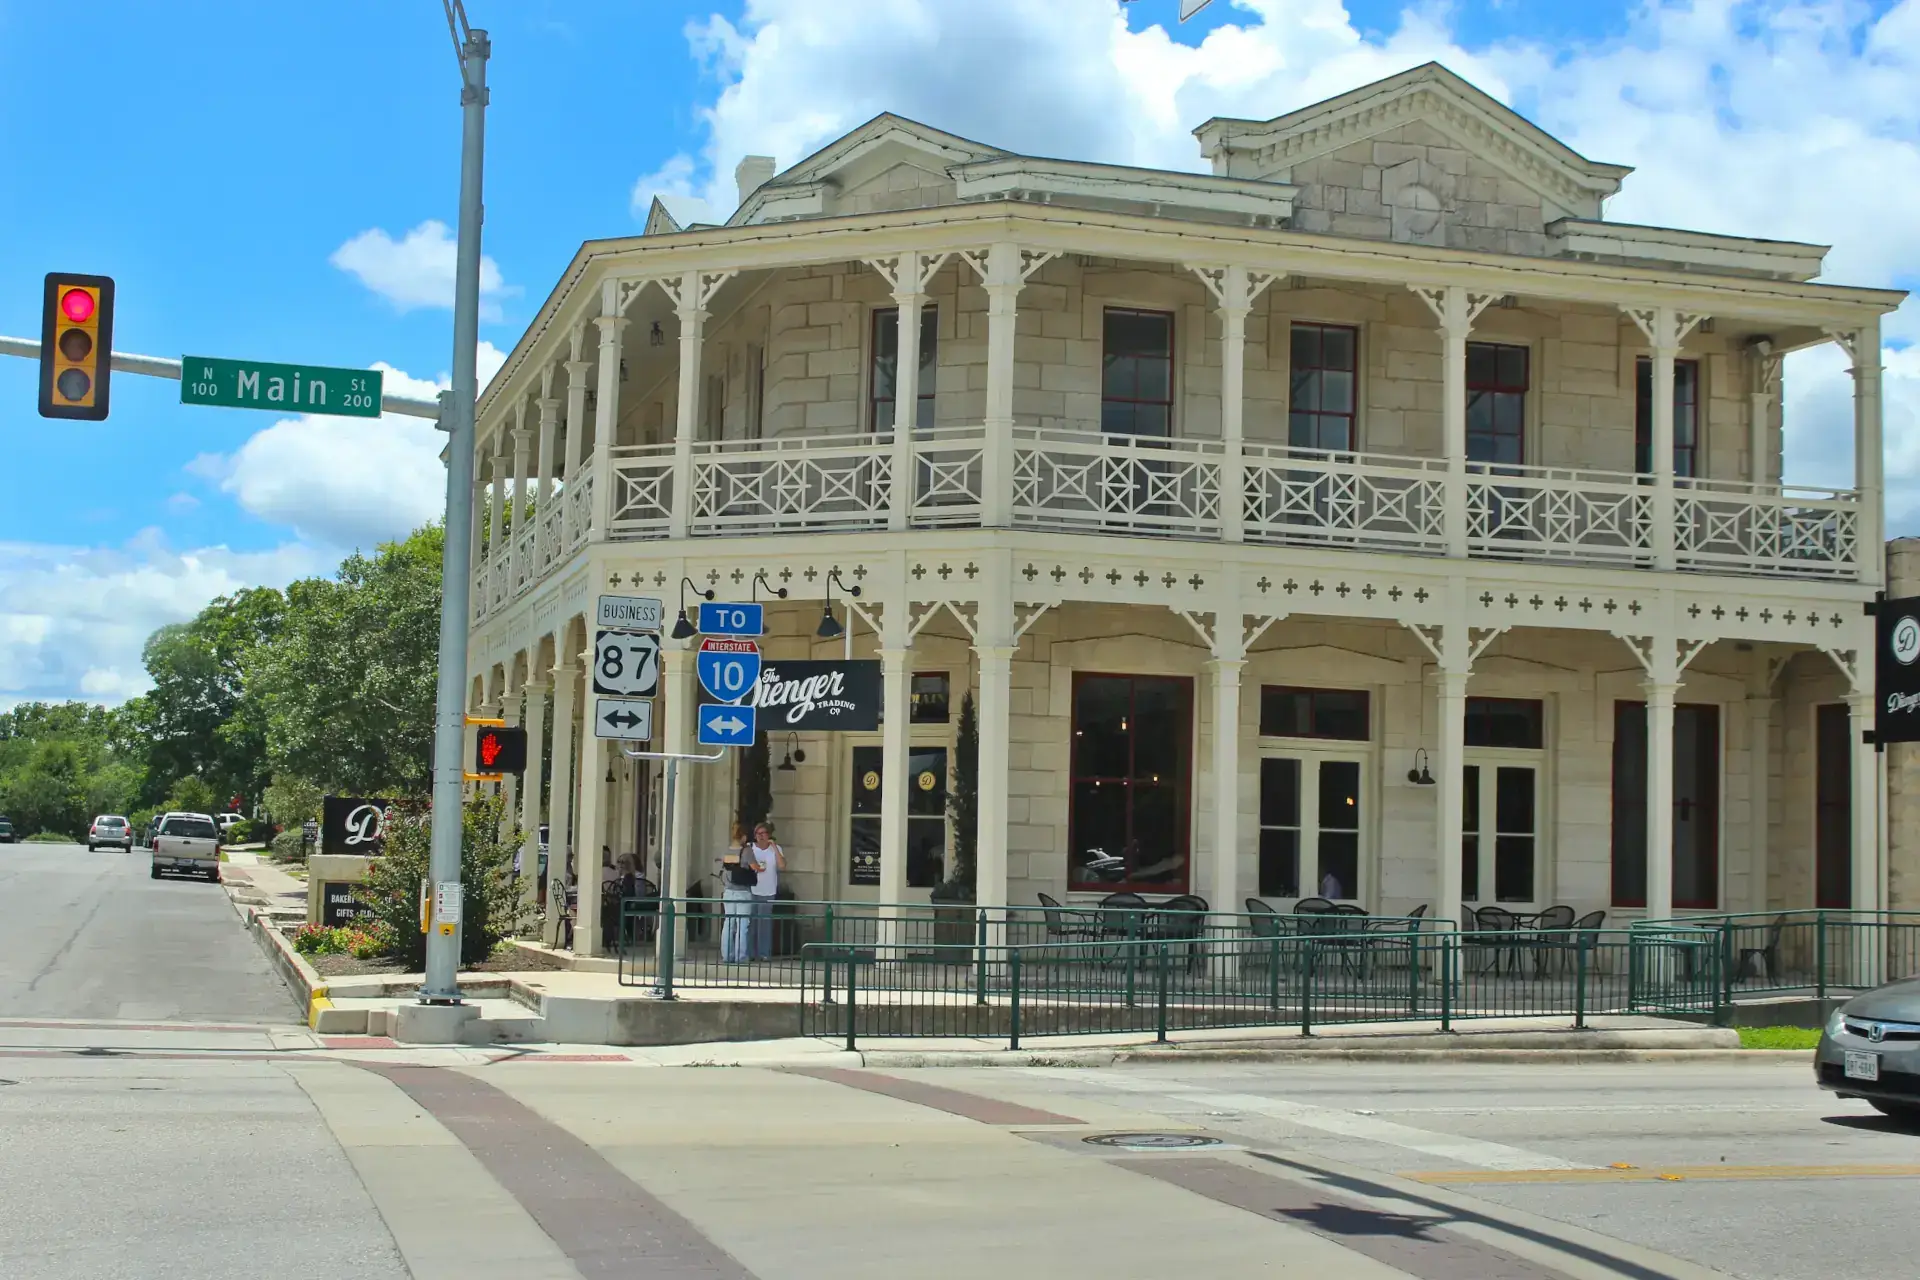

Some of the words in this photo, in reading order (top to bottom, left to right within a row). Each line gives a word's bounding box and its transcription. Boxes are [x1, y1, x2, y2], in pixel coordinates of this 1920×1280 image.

[191, 382, 218, 396] 100
[203, 367, 213, 380] N
[237, 369, 326, 405] Main
[351, 378, 366, 392] St
[343, 394, 372, 408] 200
[603, 604, 656, 622] BUSINESS
[715, 609, 746, 629] TO
[707, 641, 751, 652] INTERSTATE
[602, 645, 652, 680] 87
[713, 661, 744, 691] 10
[761, 667, 780, 683] The
[816, 699, 856, 710] TRADING
[336, 908, 355, 918] GIFTS
